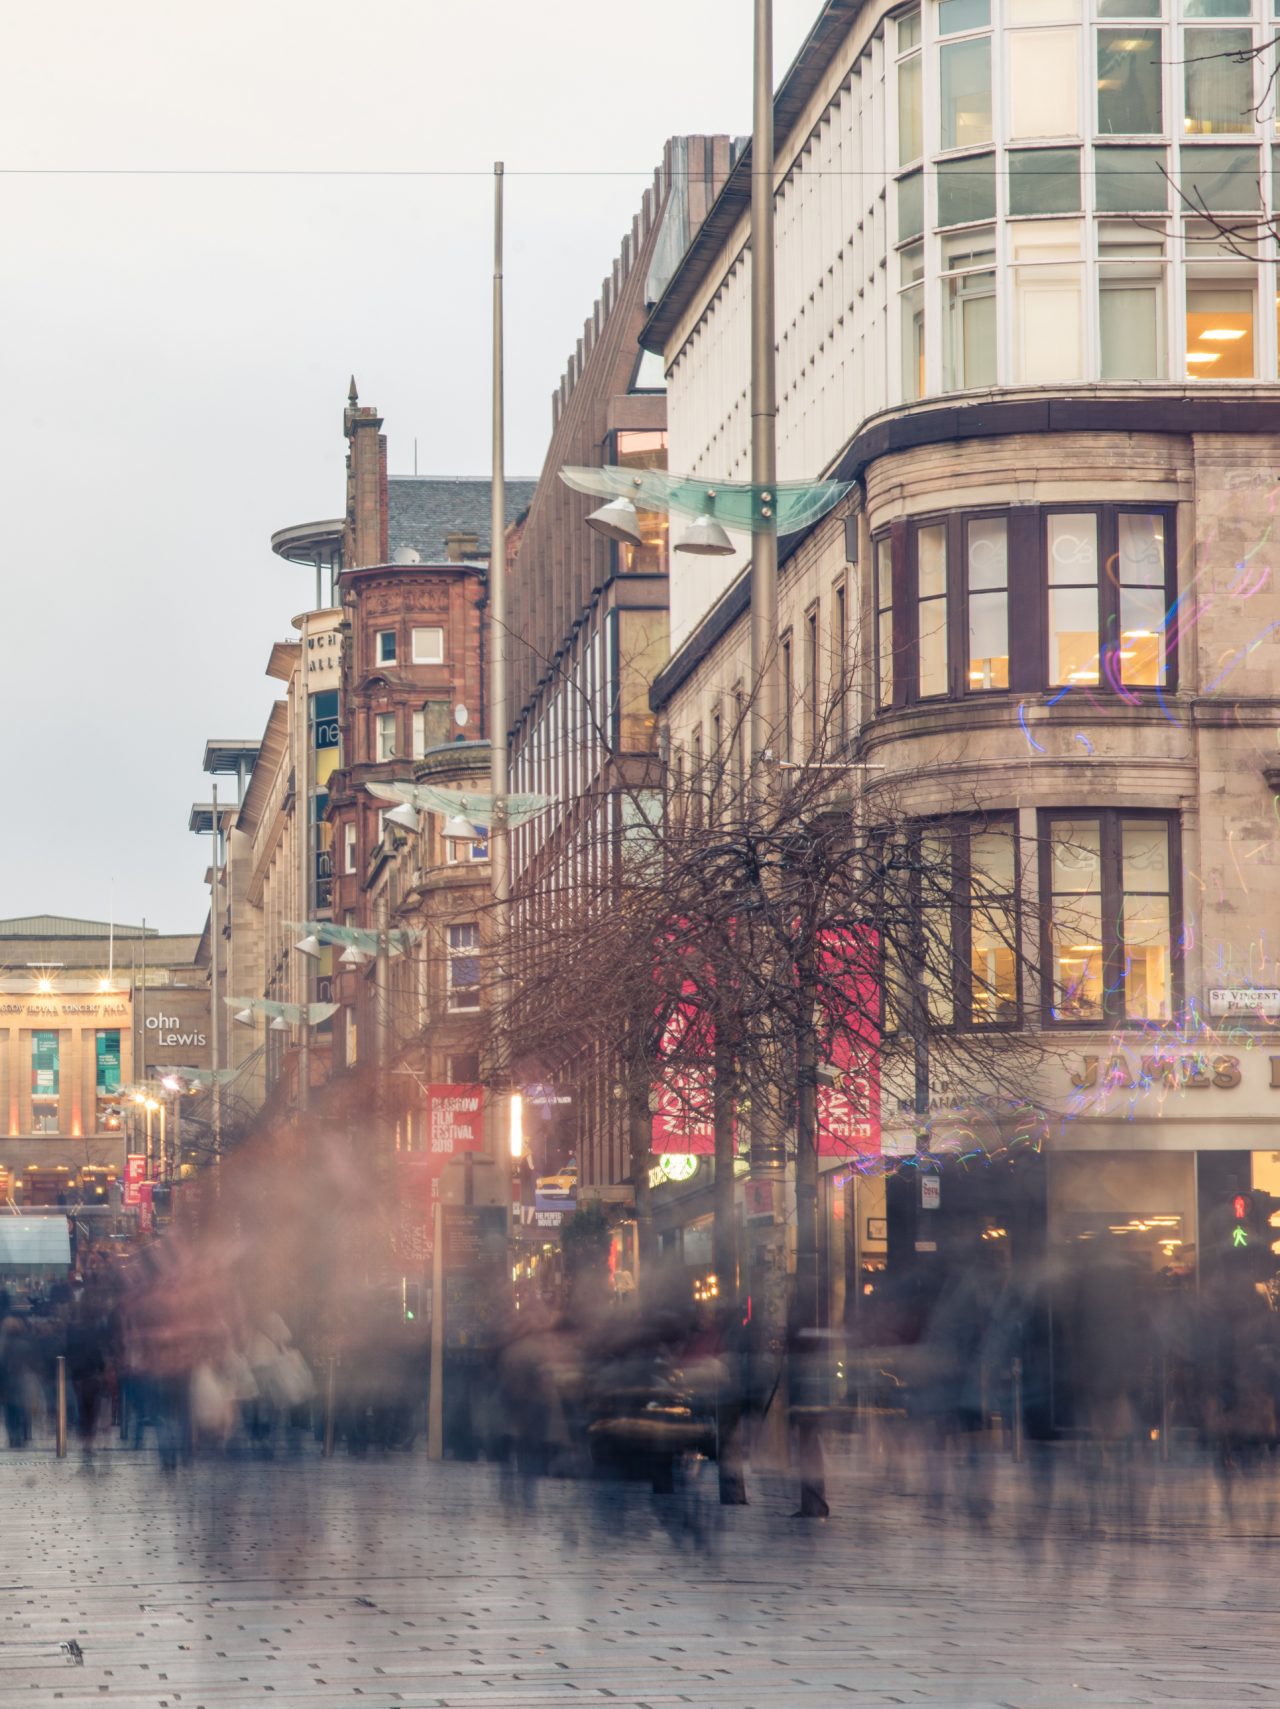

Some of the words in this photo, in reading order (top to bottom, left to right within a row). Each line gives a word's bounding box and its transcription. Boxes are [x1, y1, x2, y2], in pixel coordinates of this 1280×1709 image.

[307, 634, 337, 650] UCH
[318, 723, 340, 744] ne
[1230, 991, 1278, 1000] VINCENT
[141, 1012, 180, 1030] ohn
[159, 1029, 206, 1046] Lewis
[1071, 1055, 1242, 1088] JAMES
[431, 1097, 479, 1112] GLASGOW
[431, 1111, 454, 1125] FILM
[431, 1124, 474, 1140] FESTIVAL
